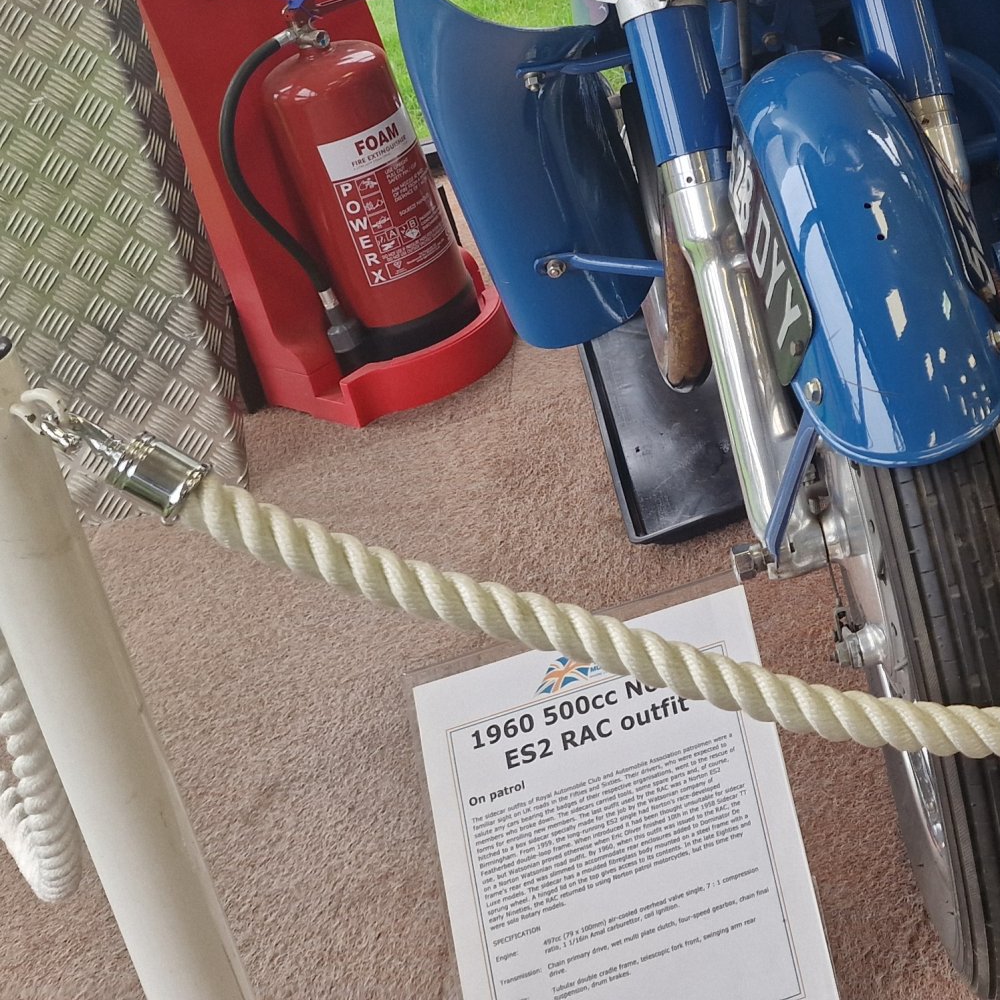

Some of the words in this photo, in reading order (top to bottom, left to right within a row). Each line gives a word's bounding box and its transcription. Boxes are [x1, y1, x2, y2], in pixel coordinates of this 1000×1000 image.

[351, 158, 367, 168] FIRE
[354, 123, 399, 155] FOAM
[752, 204, 802, 349] DYY
[471, 713, 535, 750] 1960
[544, 690, 618, 728] 500cc
[505, 744, 554, 770] ES2
[561, 723, 613, 751] RAC
[621, 696, 689, 731] outfit
[468, 793, 487, 807] On
[489, 780, 526, 804] patrol
[473, 820, 495, 831] familiar
[570, 790, 588, 799] Fifties
[694, 745, 719, 758] expected
[474, 829, 493, 839] salute
[521, 812, 544, 823] bearing
[556, 801, 578, 811] badges
[602, 783, 632, 796] respective
[709, 751, 728, 760] rescue
[484, 809, 506, 819] sidecar
[507, 802, 527, 812] outfits
[553, 782, 587, 796] Automobile
[615, 762, 648, 776] Automobile
[649, 750, 682, 765] Association
[683, 740, 712, 755] patrolmen
[476, 833, 504, 846] members
[570, 803, 594, 815] sidecars
[596, 794, 617, 806] carried
[478, 849, 500, 862] hitched
[528, 834, 549, 845] sidecar
[551, 825, 577, 837] specially
[648, 791, 679, 804] Watsonian
[680, 782, 706, 794] company
[480, 860, 515, 877] Featherbed
[516, 849, 552, 865] double-loop
[592, 824, 624, 839] introduced
[659, 804, 683, 817] thought
[684, 795, 714, 808] unsuitable
[725, 784, 745, 795] sidecar
[506, 832, 532, 844] enrolling
[604, 801, 619, 811] outfit
[688, 773, 708, 783] Norton
[508, 861, 540, 876] Watsonian
[564, 843, 593, 857] otherwise
[643, 817, 666, 830] finished
[716, 794, 739, 805] Sidecar
[567, 824, 605, 840] long-running
[651, 800, 675, 812] Norton's
[677, 783, 721, 803] race-developed
[716, 826, 739, 837] Eighties
[485, 888, 507, 900] frame's
[550, 864, 575, 878] slimmed
[585, 848, 625, 866] accommodate
[521, 865, 552, 880] Watsonian
[541, 878, 562, 889] sidecar
[582, 862, 607, 875] moulded
[655, 837, 681, 850] mounted
[560, 885, 586, 899] returned
[581, 919, 607, 933] 100mm)
[608, 908, 638, 924] air-cooled
[639, 898, 667, 913] overhead
[722, 867, 759, 884] compression
[493, 926, 541, 947] SPECIFICATION
[496, 950, 518, 963] Engine:
[552, 982, 576, 994] Tubular
[577, 974, 598, 985] double
[599, 967, 618, 977] cradle
[640, 948, 670, 963] telescopic
[703, 928, 730, 940] swinging
[567, 951, 591, 965] primary
[678, 908, 711, 924] four-speed
[567, 935, 589, 946] 1/16in
[500, 967, 542, 986] Transmission:
